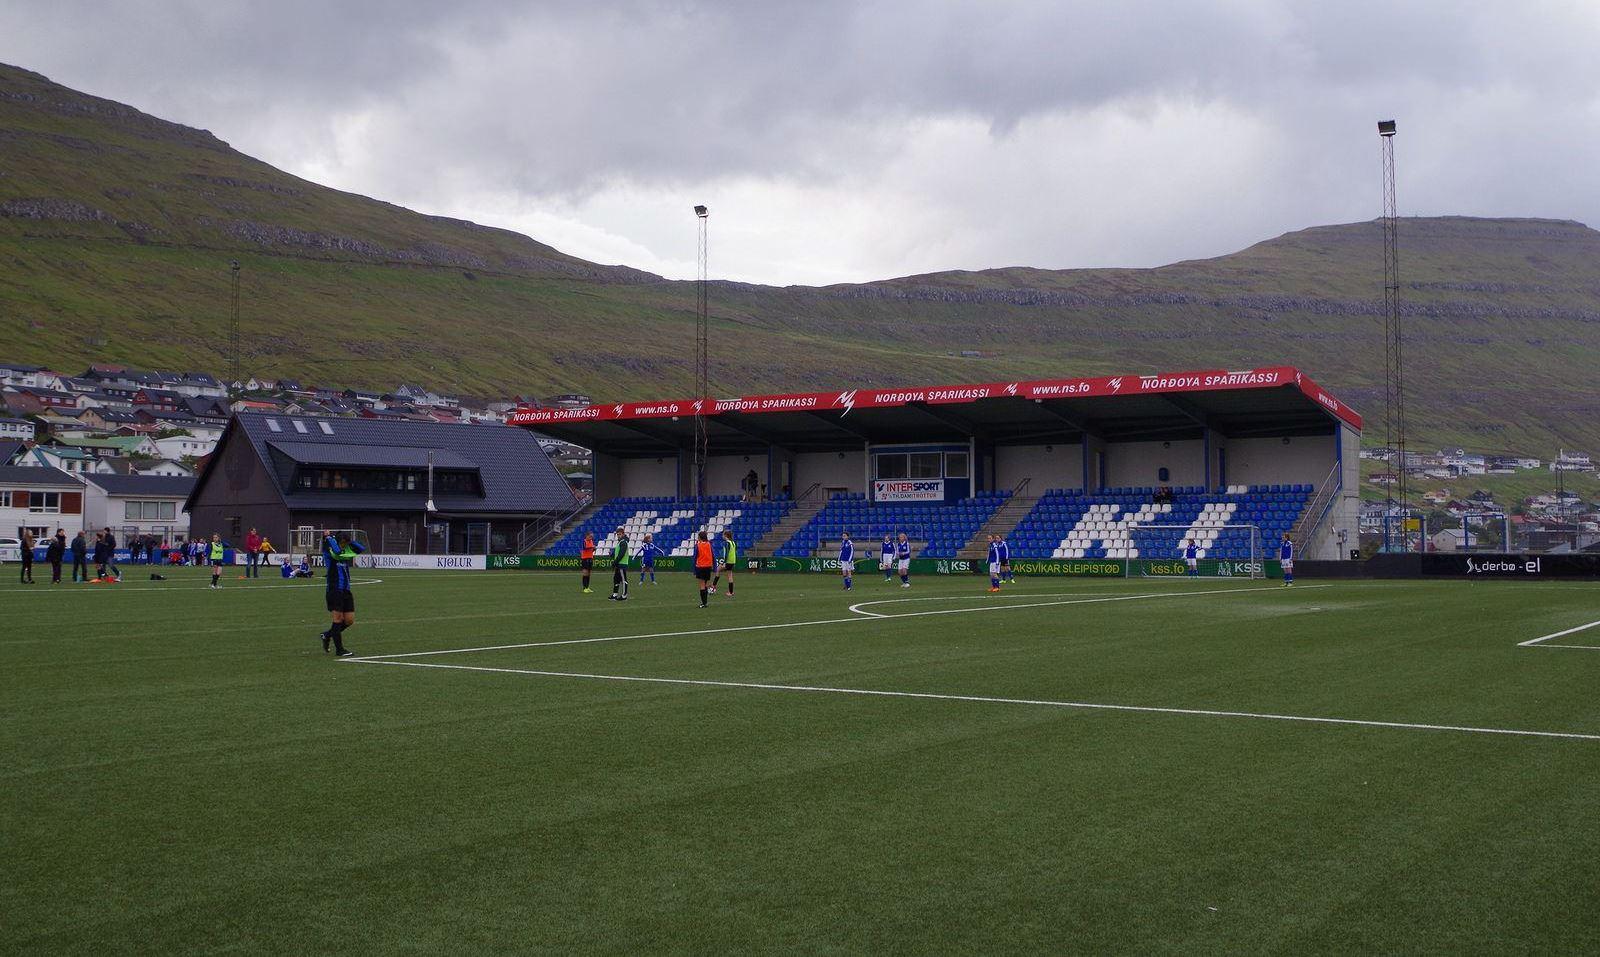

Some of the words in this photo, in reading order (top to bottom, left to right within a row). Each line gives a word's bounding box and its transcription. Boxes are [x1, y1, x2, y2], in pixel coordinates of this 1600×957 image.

[1141, 376, 1200, 389] NORÐOYA
[1204, 373, 1278, 386] SPARIKASSI
[1033, 382, 1090, 395] www.ns.fo
[875, 392, 924, 403] NORÐOYA
[928, 389, 989, 400] SPARIKASSI
[762, 398, 817, 409] SPARIKASSI
[553, 409, 599, 420] SPARIKASSI
[635, 405, 678, 415] www.ns.fo
[503, 557, 520, 565] KSS
[1525, 557, 1540, 573] el
[1151, 562, 1185, 574] kss.fo
